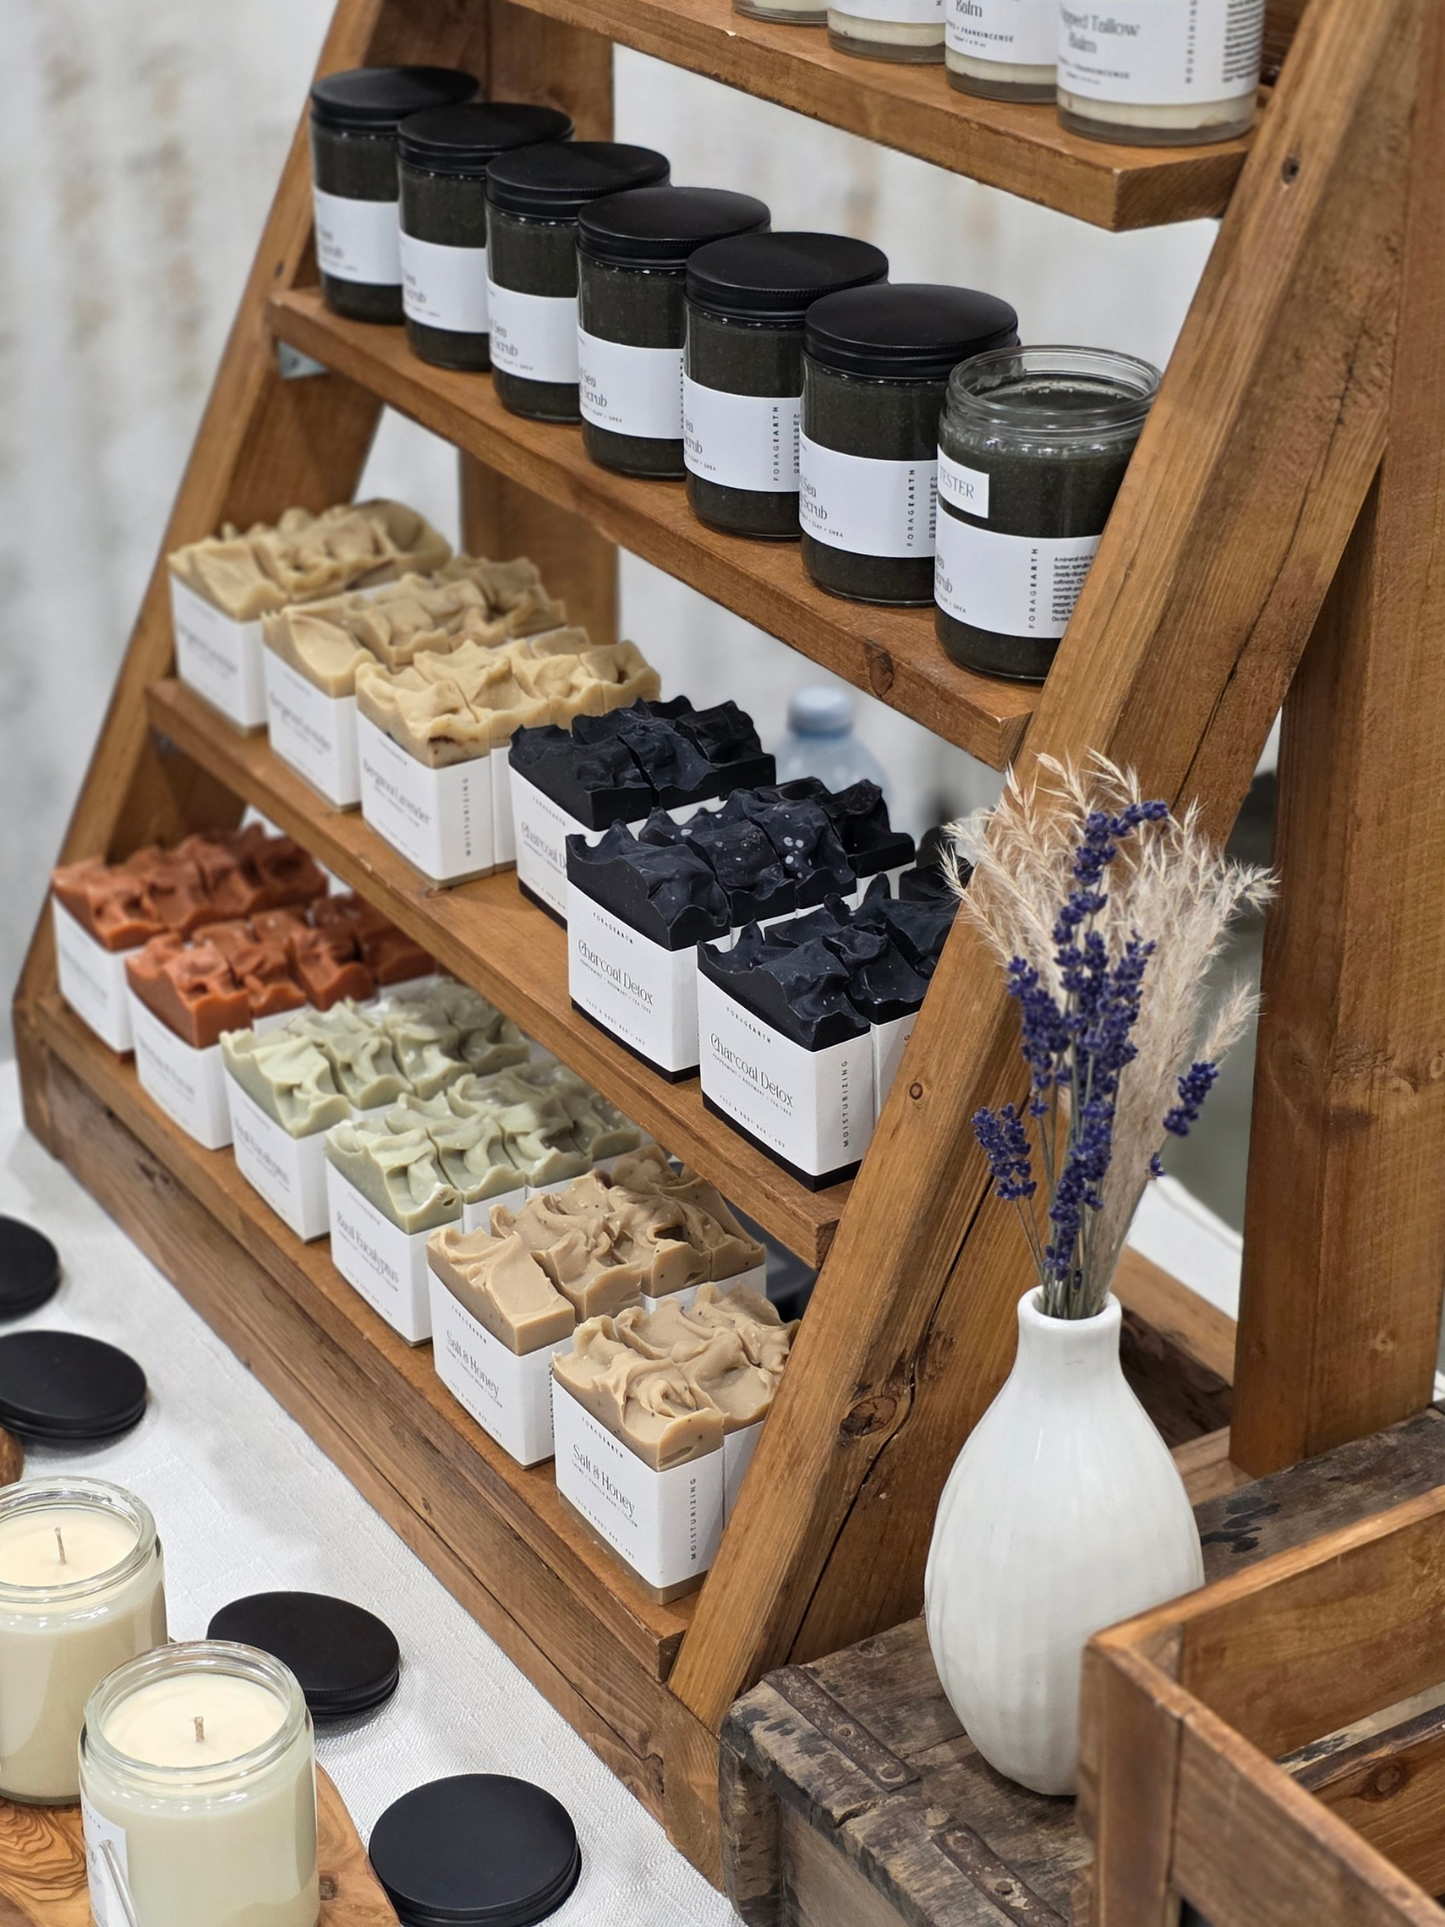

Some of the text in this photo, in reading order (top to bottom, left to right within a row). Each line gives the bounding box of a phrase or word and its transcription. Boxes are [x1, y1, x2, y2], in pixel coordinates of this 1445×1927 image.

[1091, 14, 1141, 36] Tallow
[772, 406, 780, 481] FORAGEARTH
[803, 495, 828, 520] Scrub
[906, 469, 915, 547] FORAGEARTH
[939, 464, 975, 499] TESTER
[1028, 548, 1038, 629] FORAGEARTH
[578, 939, 653, 1006] Charcoal Detox
[726, 1007, 771, 1044] FORAGEARTH
[711, 1033, 793, 1108] Charcoal Detox
[446, 1330, 462, 1358] Salt
[470, 1355, 499, 1402] Honey
[573, 1444, 635, 1518] Salt & Honey
